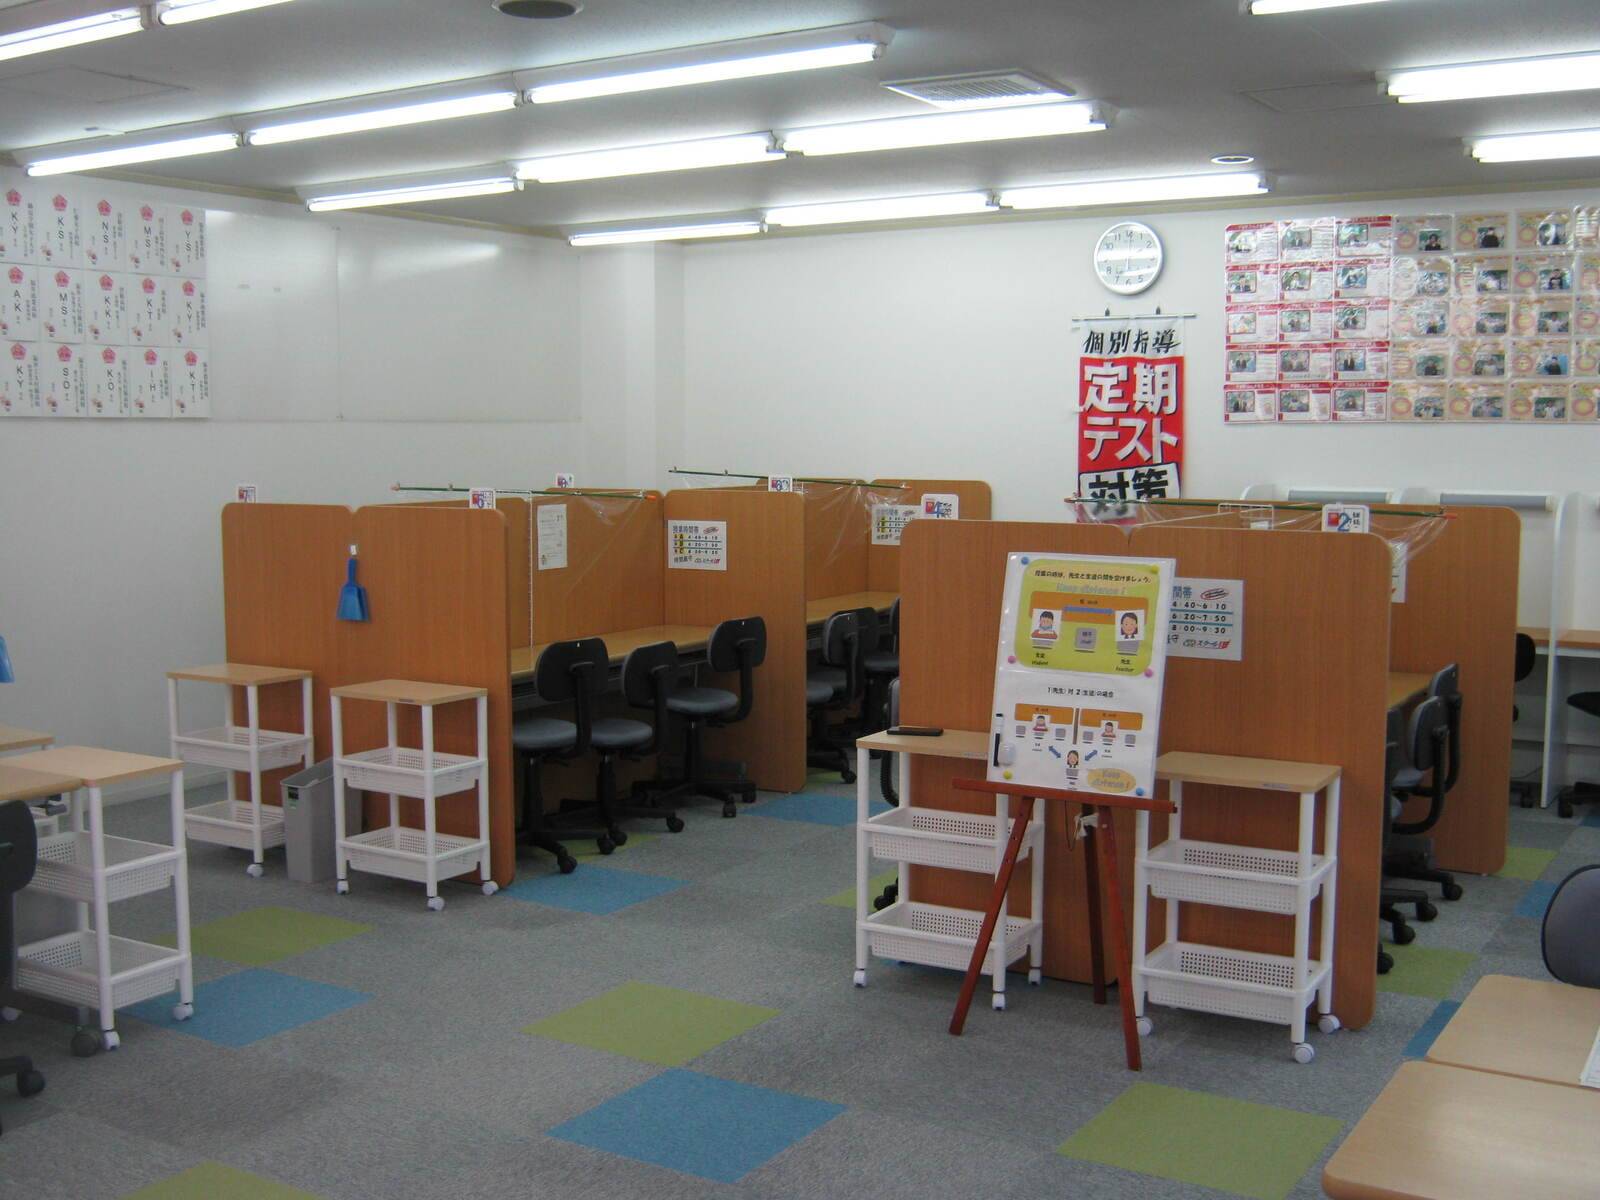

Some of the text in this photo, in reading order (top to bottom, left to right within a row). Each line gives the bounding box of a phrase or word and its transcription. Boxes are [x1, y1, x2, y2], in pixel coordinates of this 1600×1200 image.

[1083, 329, 1181, 355] 個別指導
[1082, 361, 1178, 415] 定期
[1083, 416, 1178, 465] テスト
[929, 501, 945, 518] 4
[1338, 512, 1351, 532] 2
